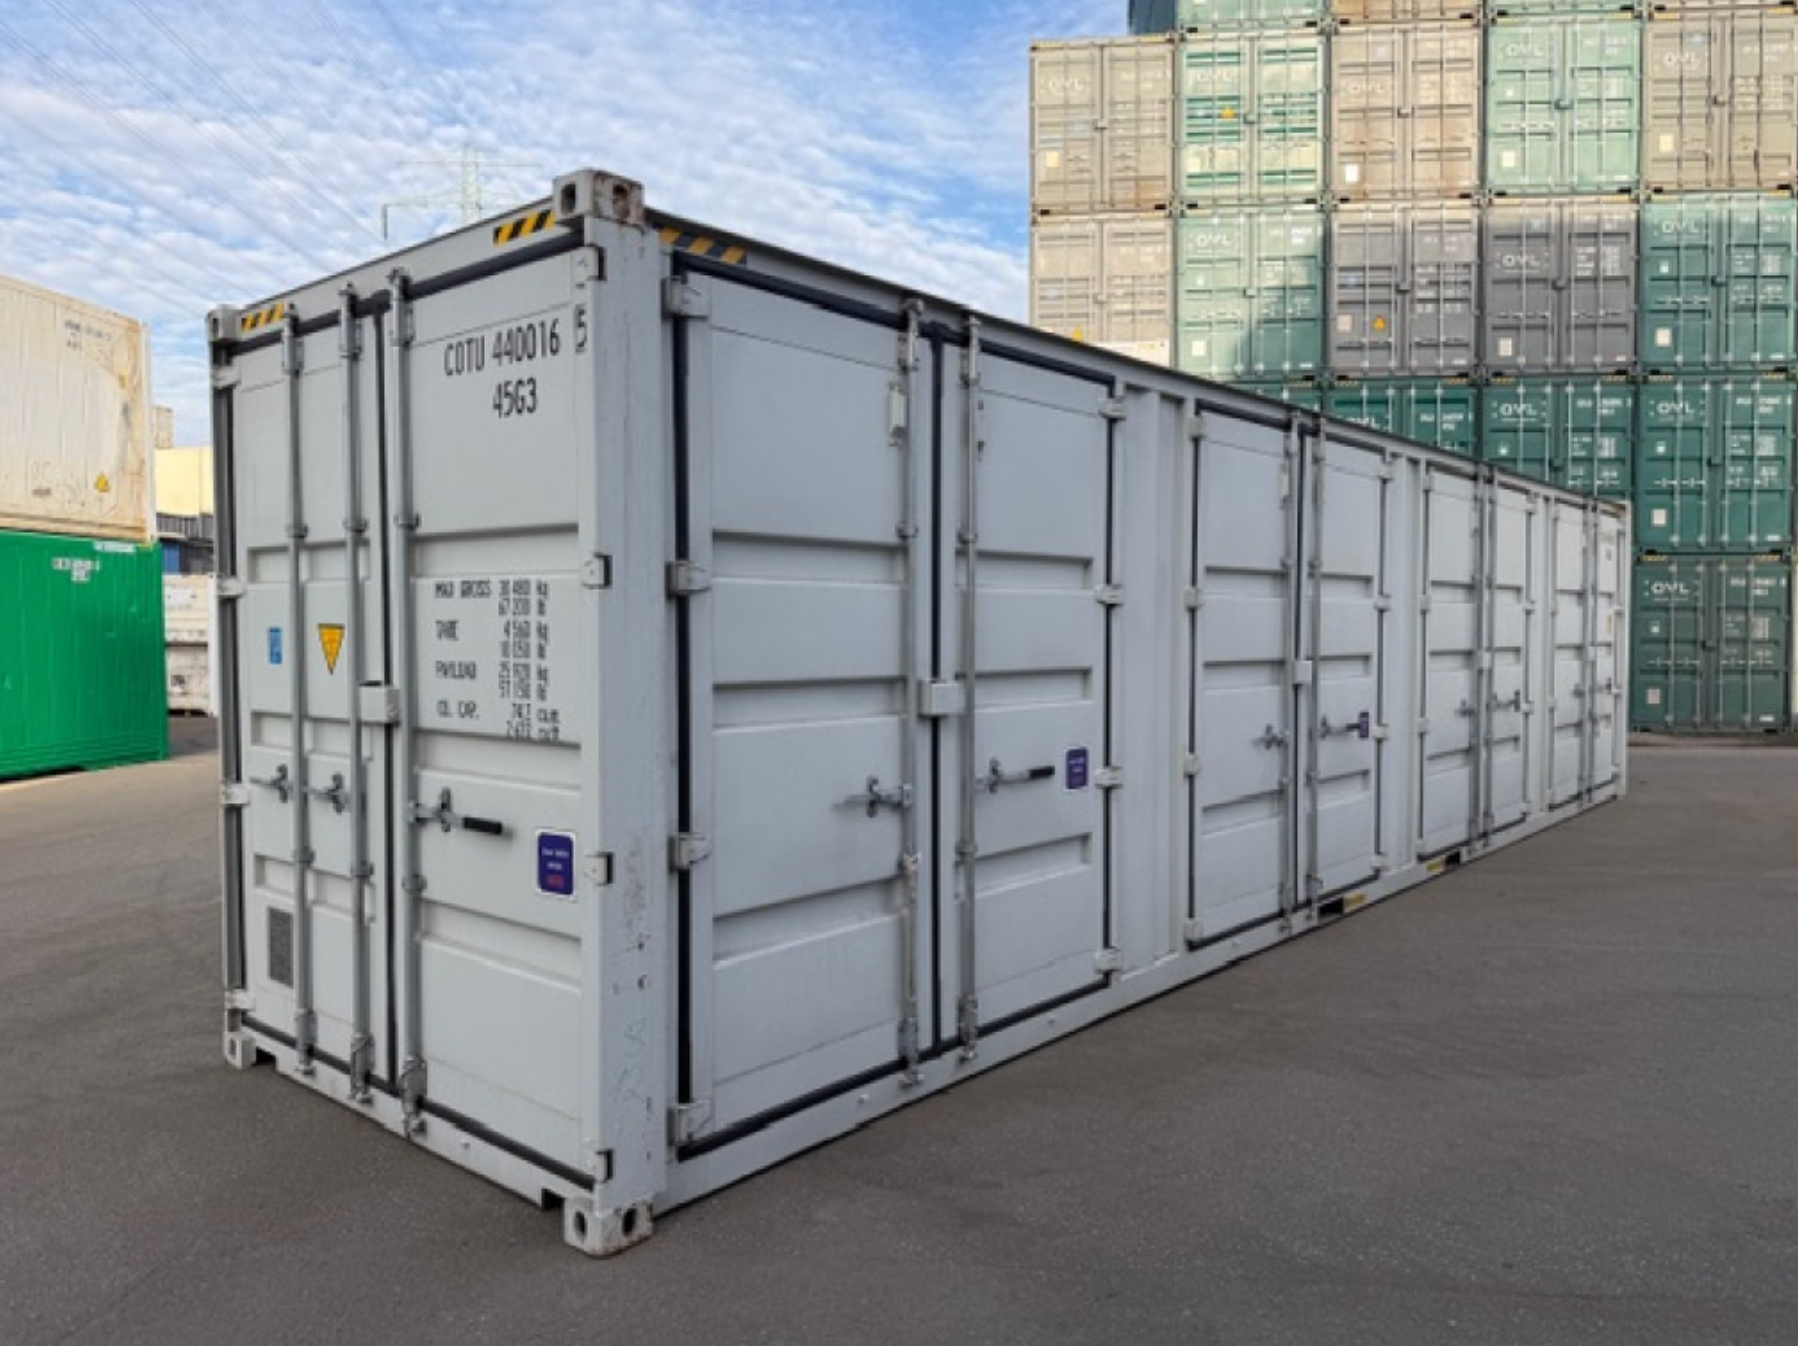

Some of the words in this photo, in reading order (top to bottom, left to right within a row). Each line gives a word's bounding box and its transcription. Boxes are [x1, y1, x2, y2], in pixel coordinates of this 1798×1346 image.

[492, 317, 561, 366] 440016
[575, 306, 588, 351] 5
[492, 375, 538, 419] 45G3
[1500, 403, 1537, 416] OVL
[1651, 580, 1689, 595] OVL
